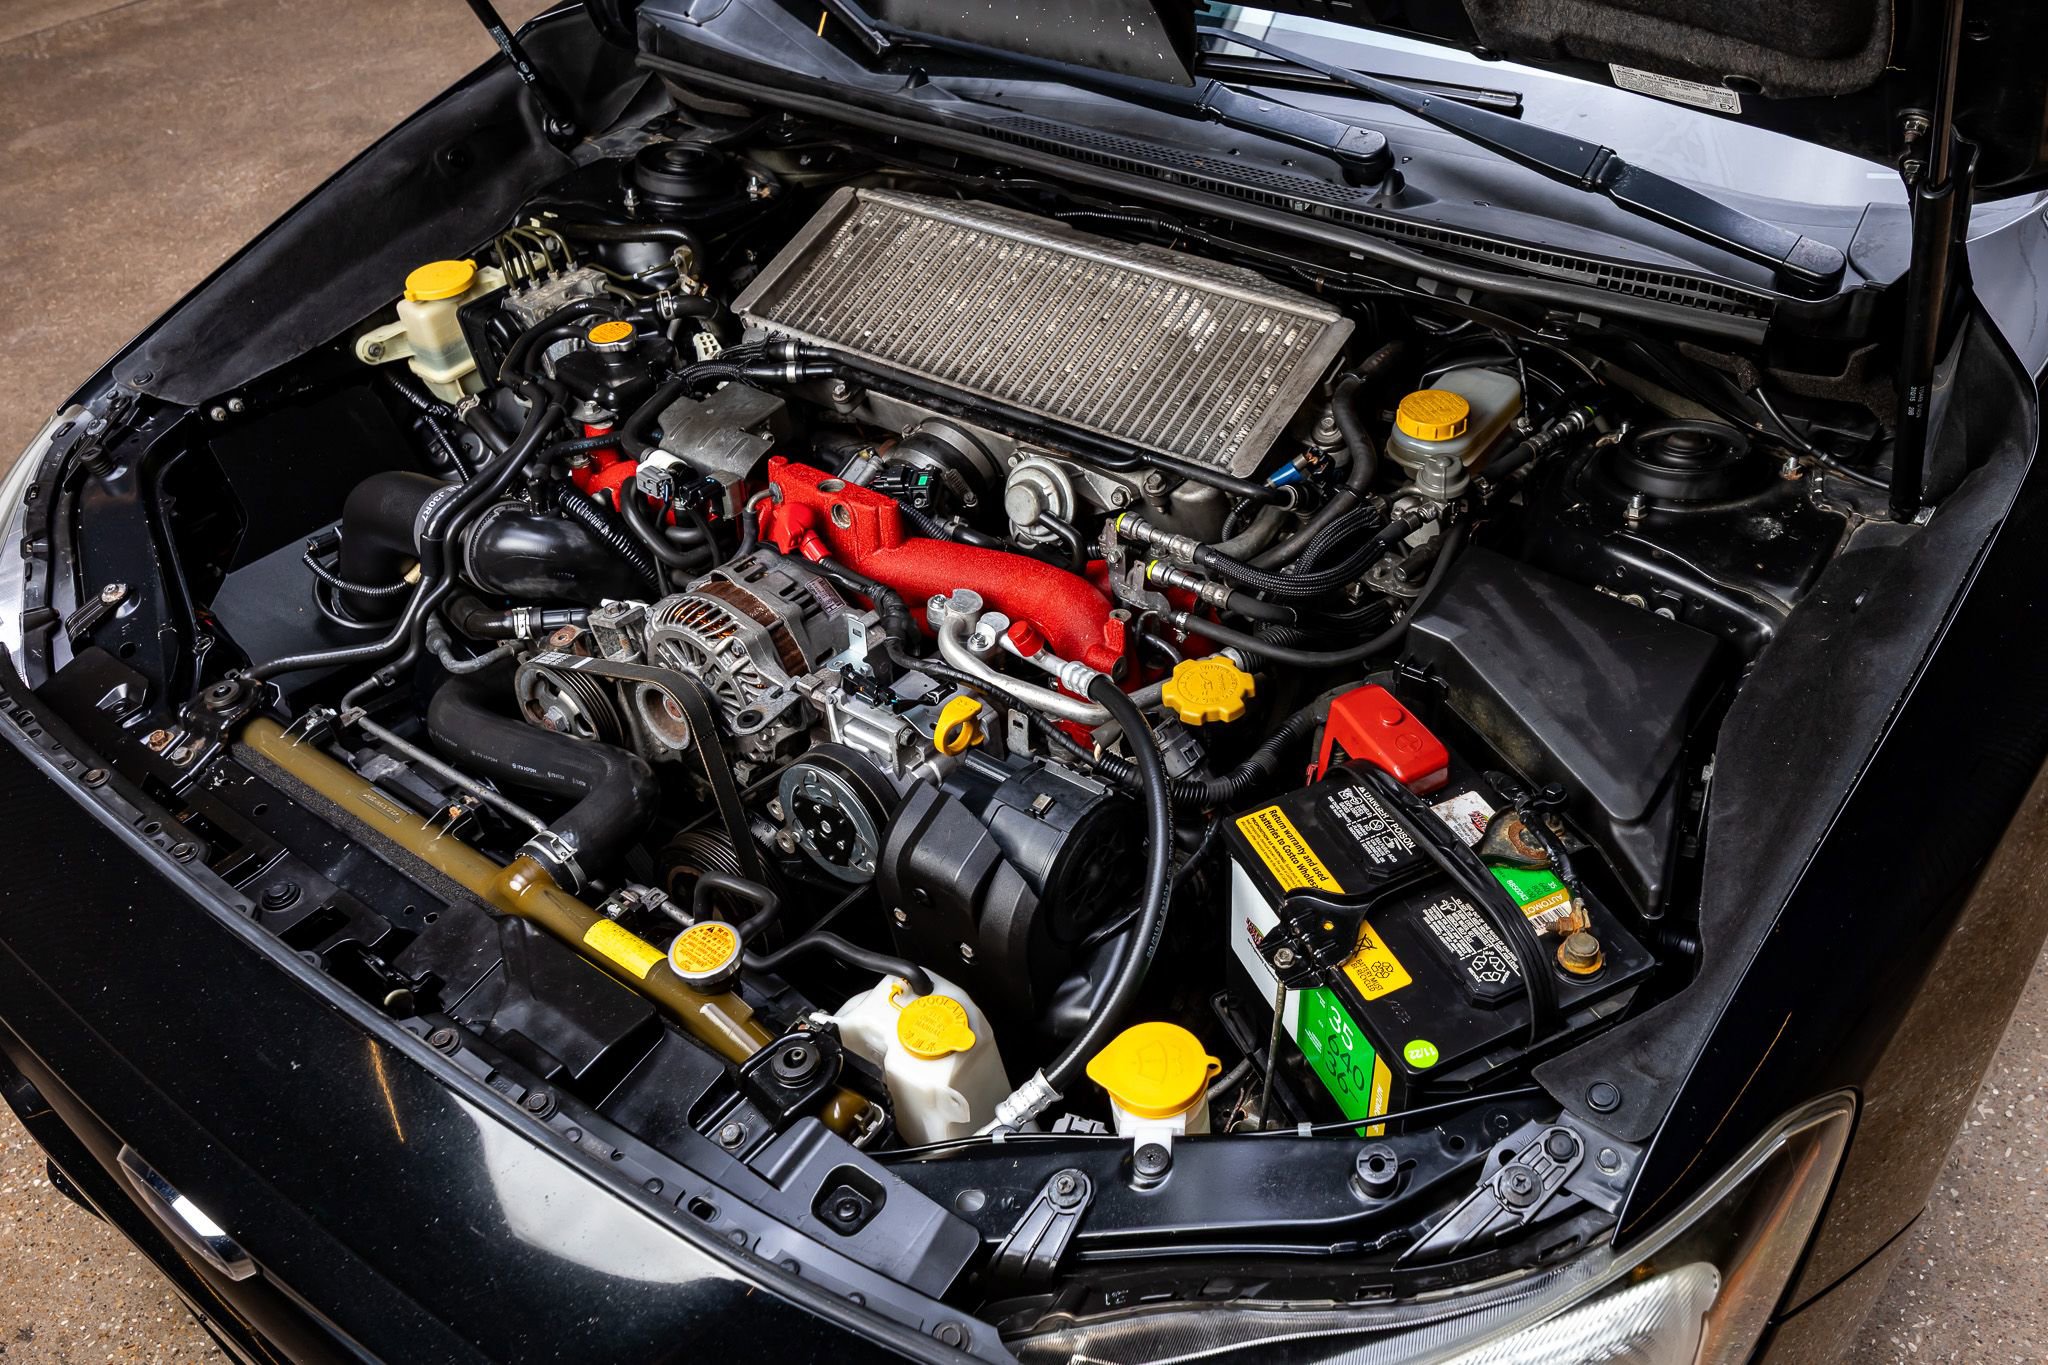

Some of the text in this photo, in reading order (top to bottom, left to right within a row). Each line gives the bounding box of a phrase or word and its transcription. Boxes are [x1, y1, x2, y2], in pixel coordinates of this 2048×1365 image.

[1720, 103, 1734, 111] EX
[1258, 814, 1286, 842] batteries
[1282, 845, 1302, 864] Costco
[1269, 810, 1328, 881] Return warranty and used
[1390, 822, 1416, 849] POISON
[1506, 879, 1529, 901] 8850242
[1547, 881, 1557, 889] 35
[1464, 934, 1474, 943] FAST
[1356, 959, 1383, 991] BATTERY MUST
[1356, 969, 1376, 992] RECYCLED
[1327, 1004, 1354, 1052] 35
[1327, 1032, 1362, 1092] 640
[1408, 1047, 1435, 1059] 11/22
